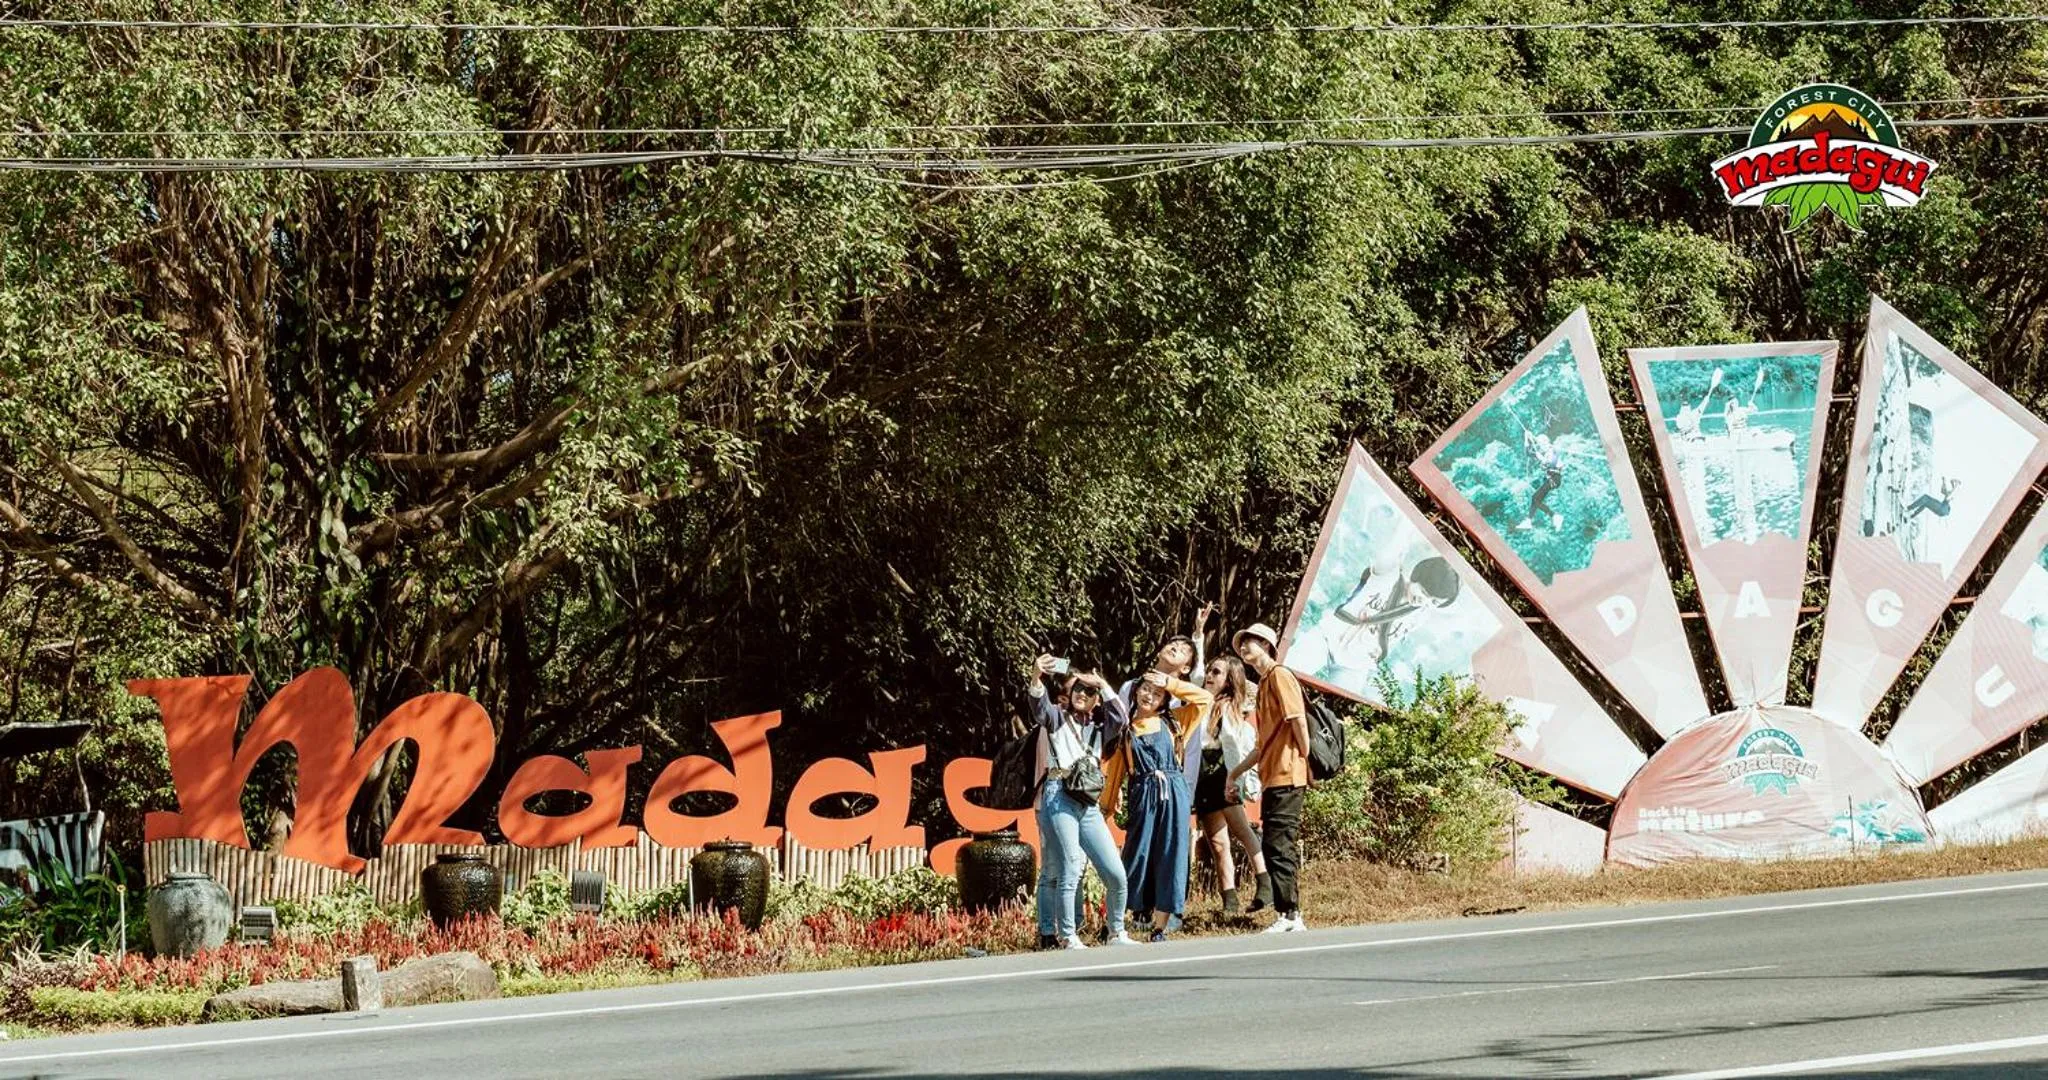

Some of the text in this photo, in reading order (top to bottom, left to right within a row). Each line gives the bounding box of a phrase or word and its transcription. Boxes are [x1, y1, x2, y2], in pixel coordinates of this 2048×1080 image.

[1597, 594, 1638, 637] D
[1734, 581, 1772, 619] A
[1866, 589, 1905, 628] G
[1975, 663, 2017, 708] U
[1672, 806, 1686, 817] to
